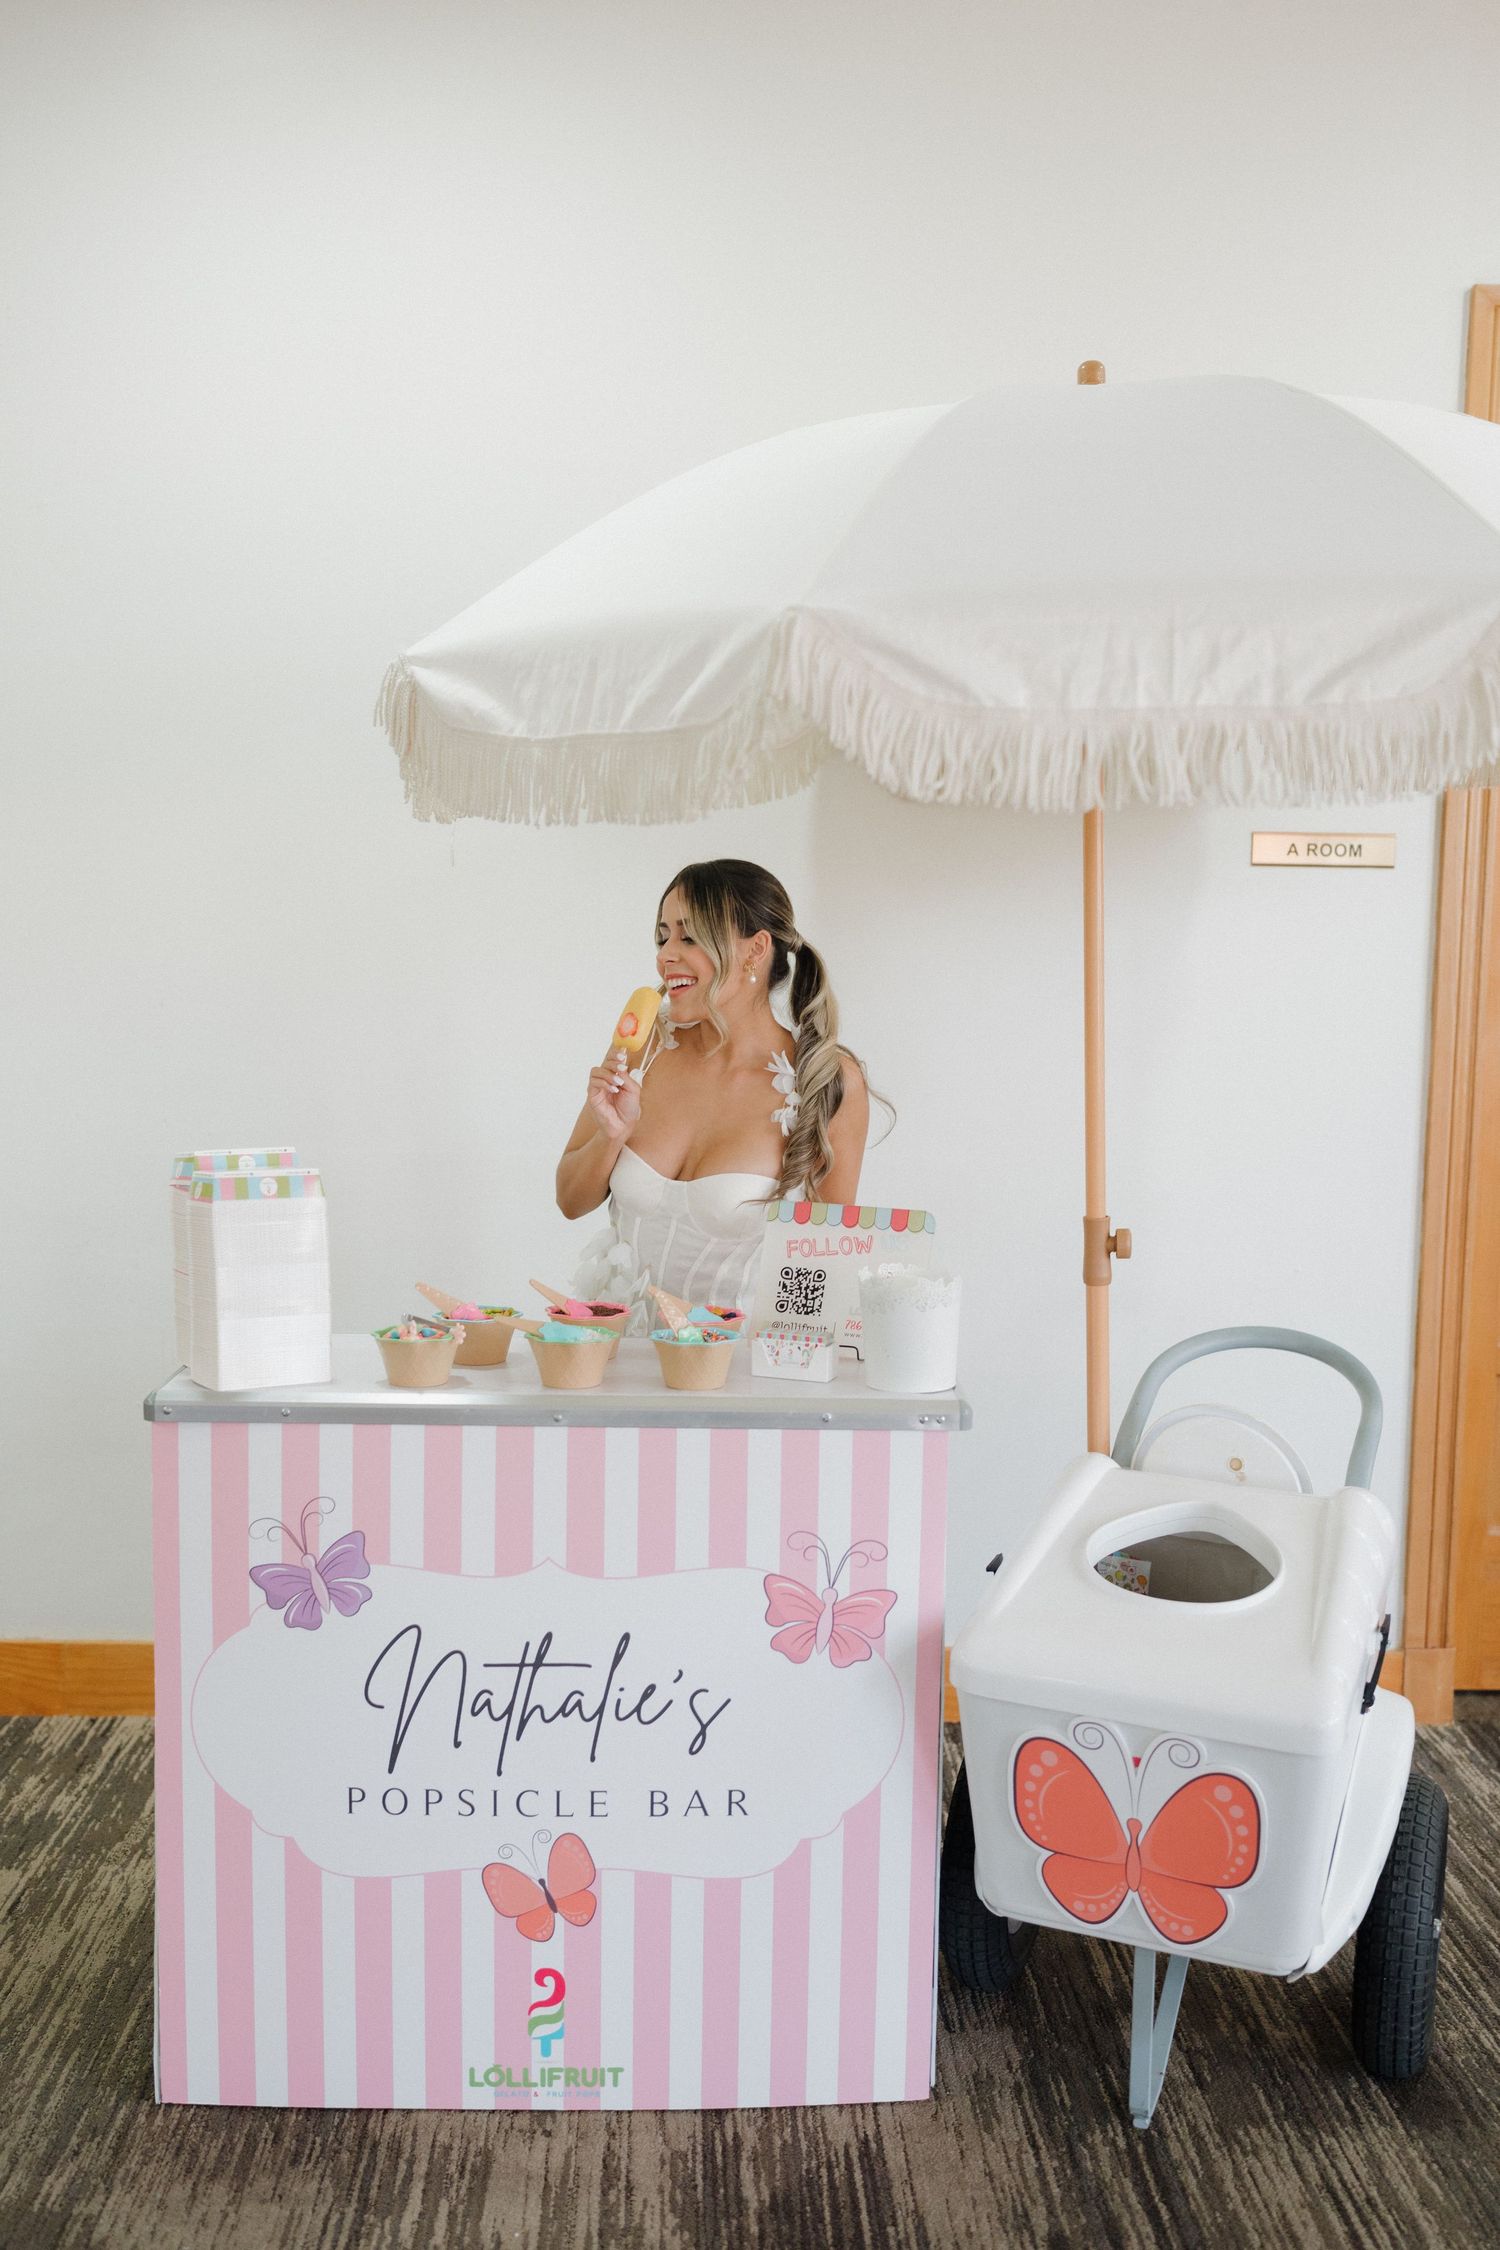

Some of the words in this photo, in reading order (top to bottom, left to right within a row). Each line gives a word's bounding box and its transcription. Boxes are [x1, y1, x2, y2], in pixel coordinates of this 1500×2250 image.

[1287, 843, 1299, 857] A
[1306, 843, 1363, 857] ROOM
[786, 1235, 873, 1258] FOLLOW
[364, 1623, 732, 1777] Nathalie's
[346, 1786, 610, 1818] POPSICLE
[648, 1788, 750, 1817] BAR
